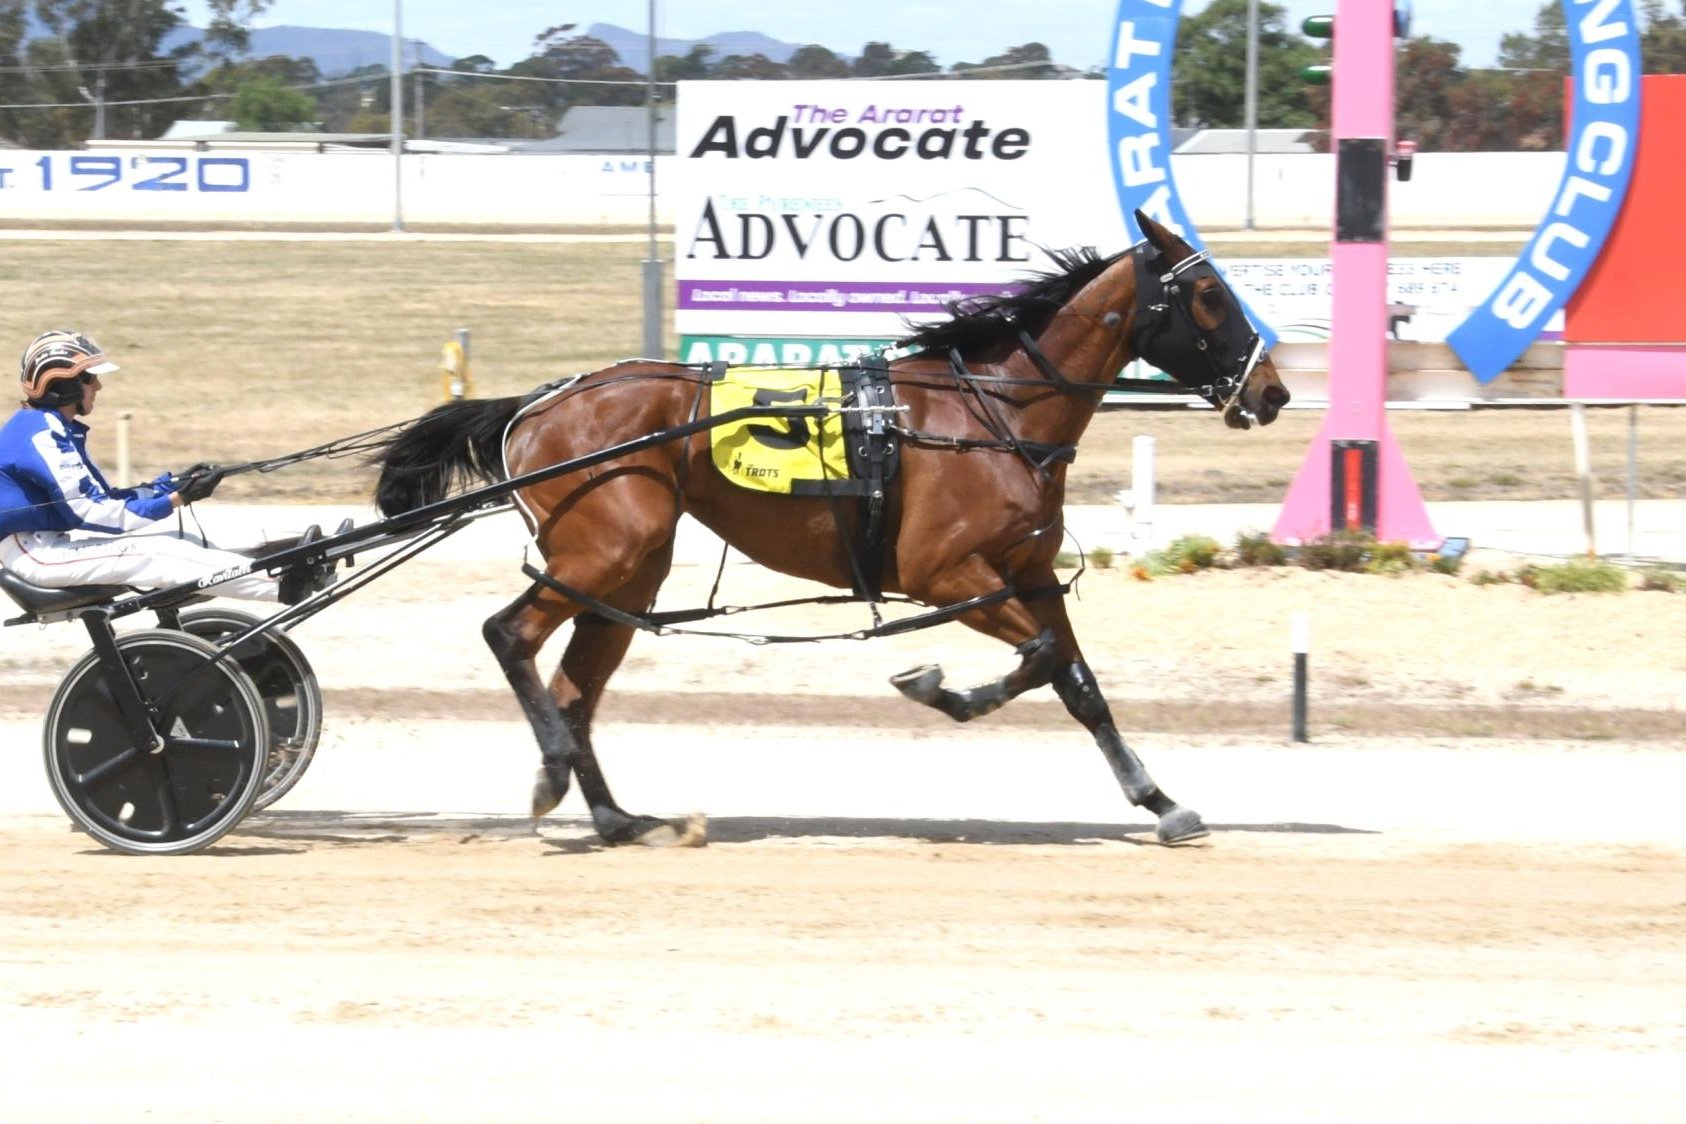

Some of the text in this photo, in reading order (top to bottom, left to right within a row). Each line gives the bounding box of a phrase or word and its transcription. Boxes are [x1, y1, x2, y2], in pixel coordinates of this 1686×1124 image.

[690, 115, 1031, 159] Advocate
[793, 104, 963, 123] The Ararat
[1113, 20, 1187, 241] ARAT
[35, 155, 250, 192] 1920
[1491, 0, 1632, 329] NG CLUB
[686, 196, 1031, 262] ADVOCATE
[746, 387, 811, 450] 5
[745, 467, 780, 478] TROTS
